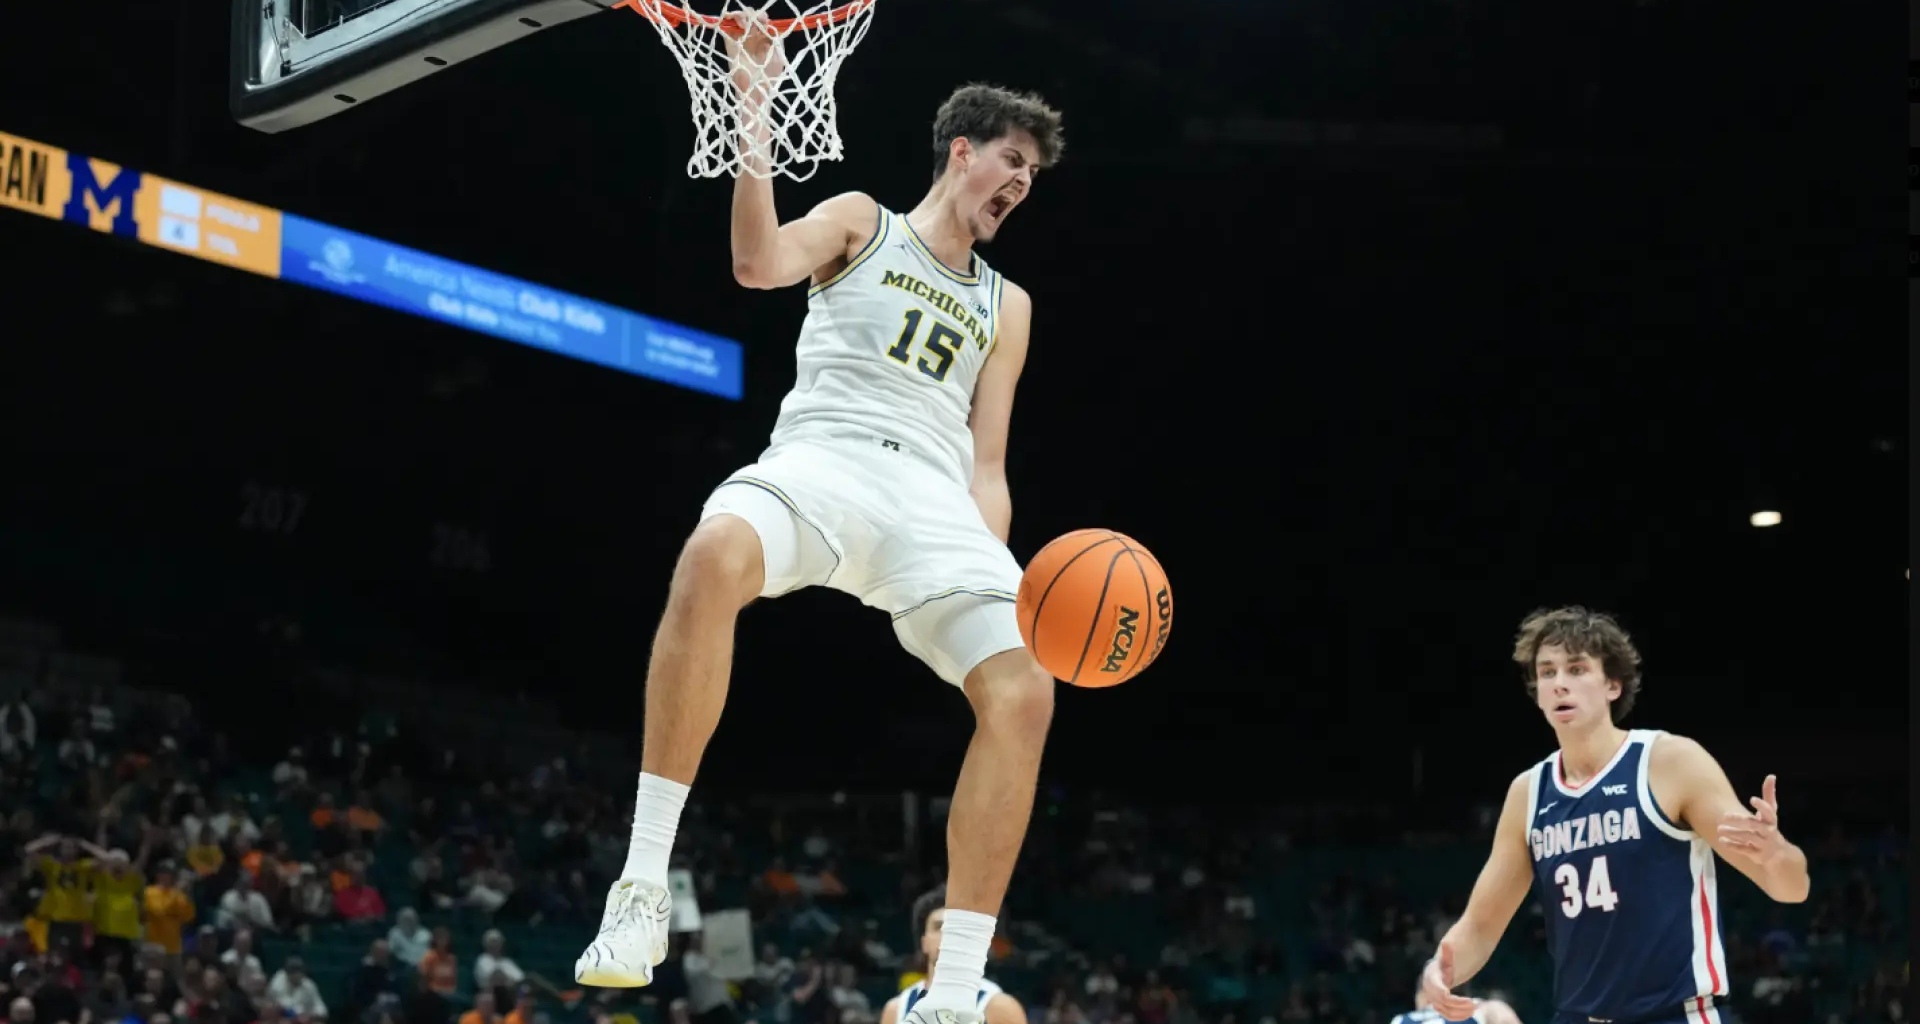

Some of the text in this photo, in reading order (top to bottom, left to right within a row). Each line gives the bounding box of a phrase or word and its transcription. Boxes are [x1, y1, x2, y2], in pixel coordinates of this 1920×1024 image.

[0, 140, 48, 206] AN
[62, 153, 143, 240] M
[880, 269, 988, 352] MICHIGAN
[886, 307, 966, 383] 15
[238, 479, 310, 534] 207
[1101, 606, 1139, 672] NCAA
[1530, 806, 1642, 863] GONZAGA
[1554, 855, 1619, 919] 34
